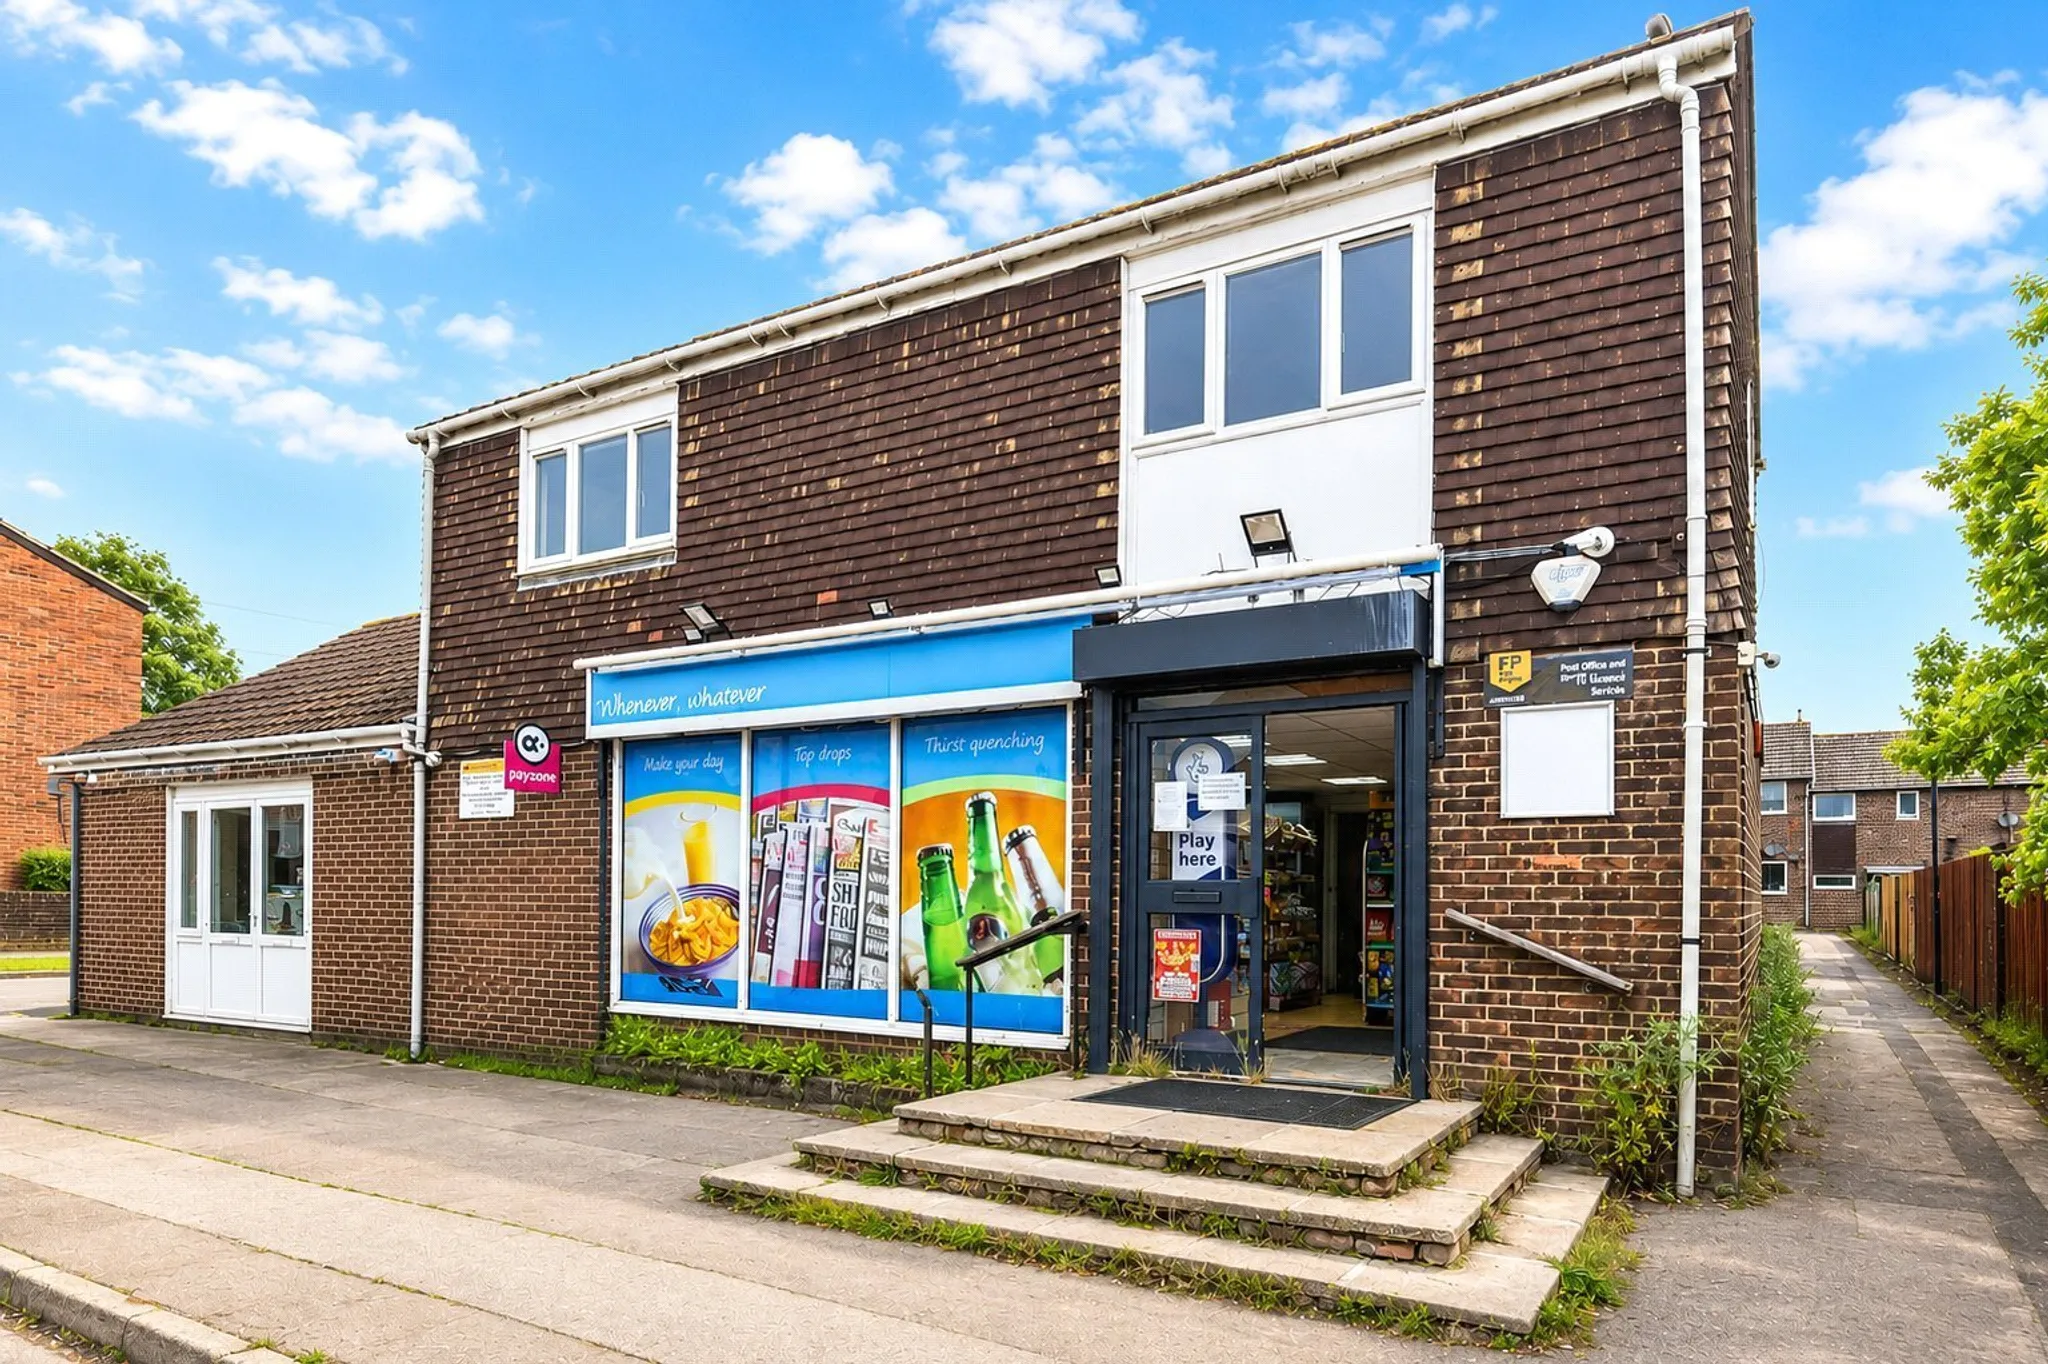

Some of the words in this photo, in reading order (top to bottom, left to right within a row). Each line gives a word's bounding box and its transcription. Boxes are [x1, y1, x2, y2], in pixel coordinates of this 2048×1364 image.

[1499, 655, 1521, 670] FP
[597, 692, 680, 717] Whenever,
[688, 685, 767, 710] whatever
[925, 736, 966, 754] Thirst
[969, 730, 1045, 757] quenching
[644, 755, 672, 771] Make
[675, 758, 699, 775] your
[702, 752, 723, 772] day
[794, 745, 815, 768] Top
[819, 744, 852, 767] drops
[509, 769, 557, 783] payzone
[1179, 833, 1215, 850] Play
[1179, 851, 1216, 866] here
